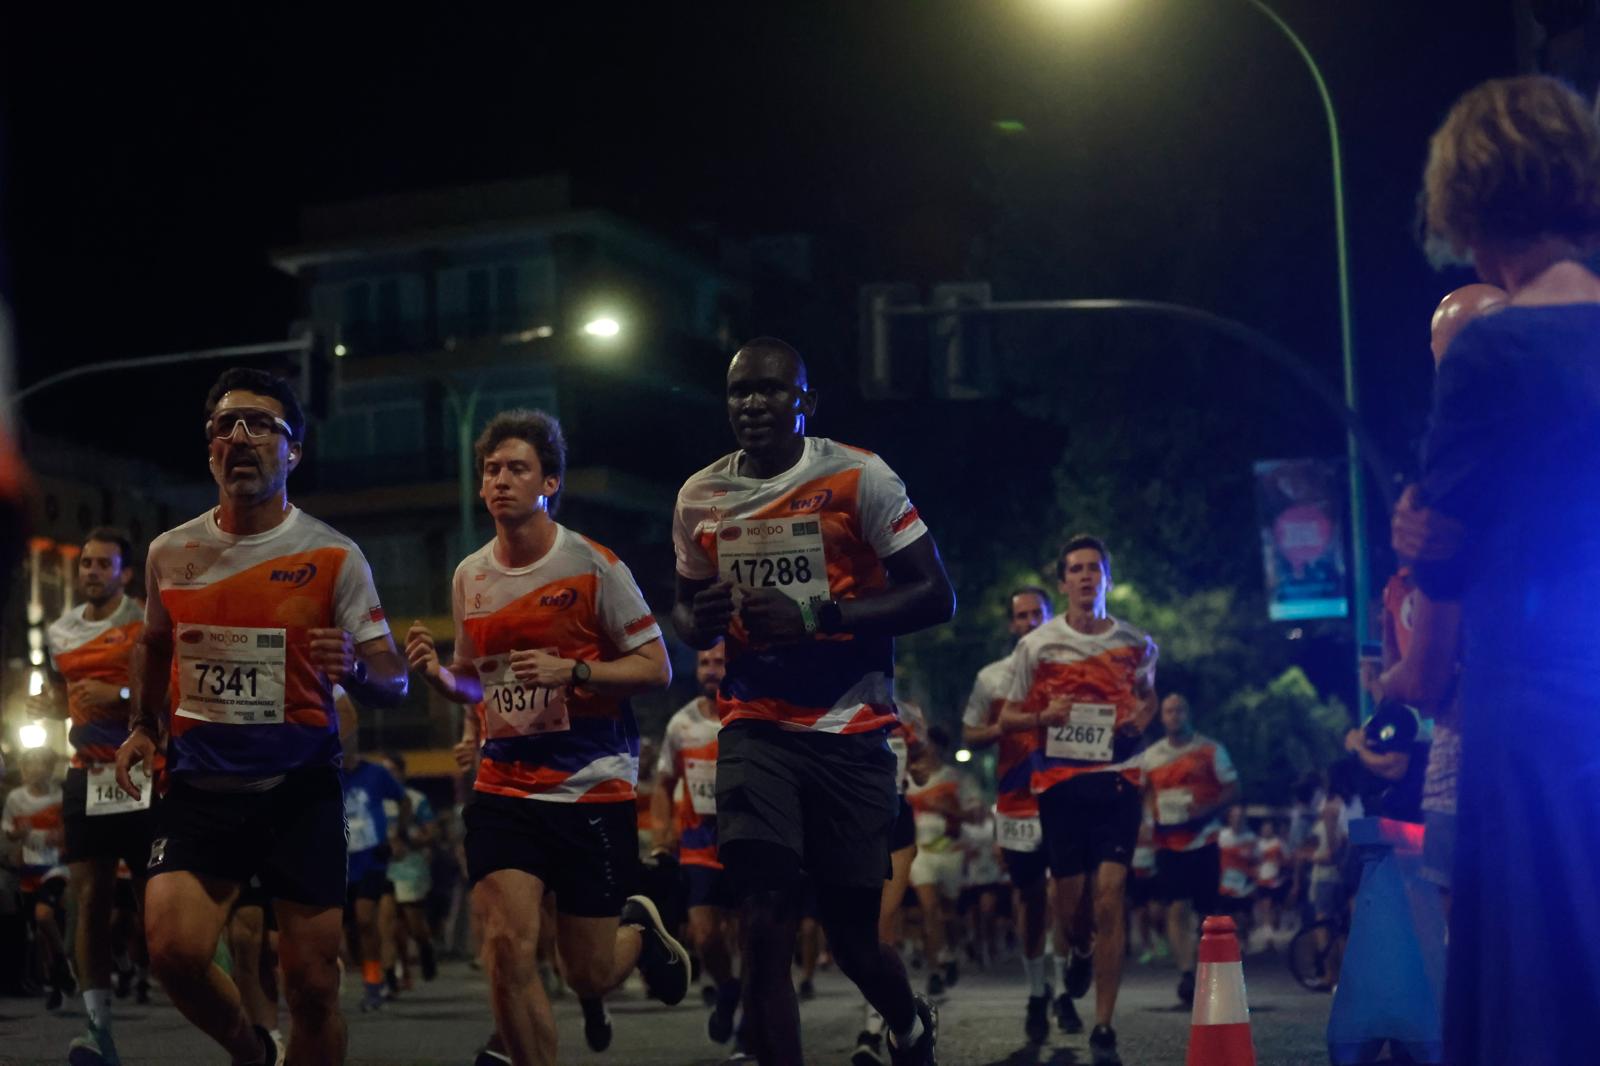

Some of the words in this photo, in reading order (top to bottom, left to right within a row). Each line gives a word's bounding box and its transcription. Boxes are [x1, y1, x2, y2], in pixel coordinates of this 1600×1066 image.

[270, 566, 311, 585] KH7
[731, 556, 811, 587] 17288
[195, 664, 256, 697] 7341
[1055, 725, 1105, 744] 22667
[97, 784, 142, 801] 146
